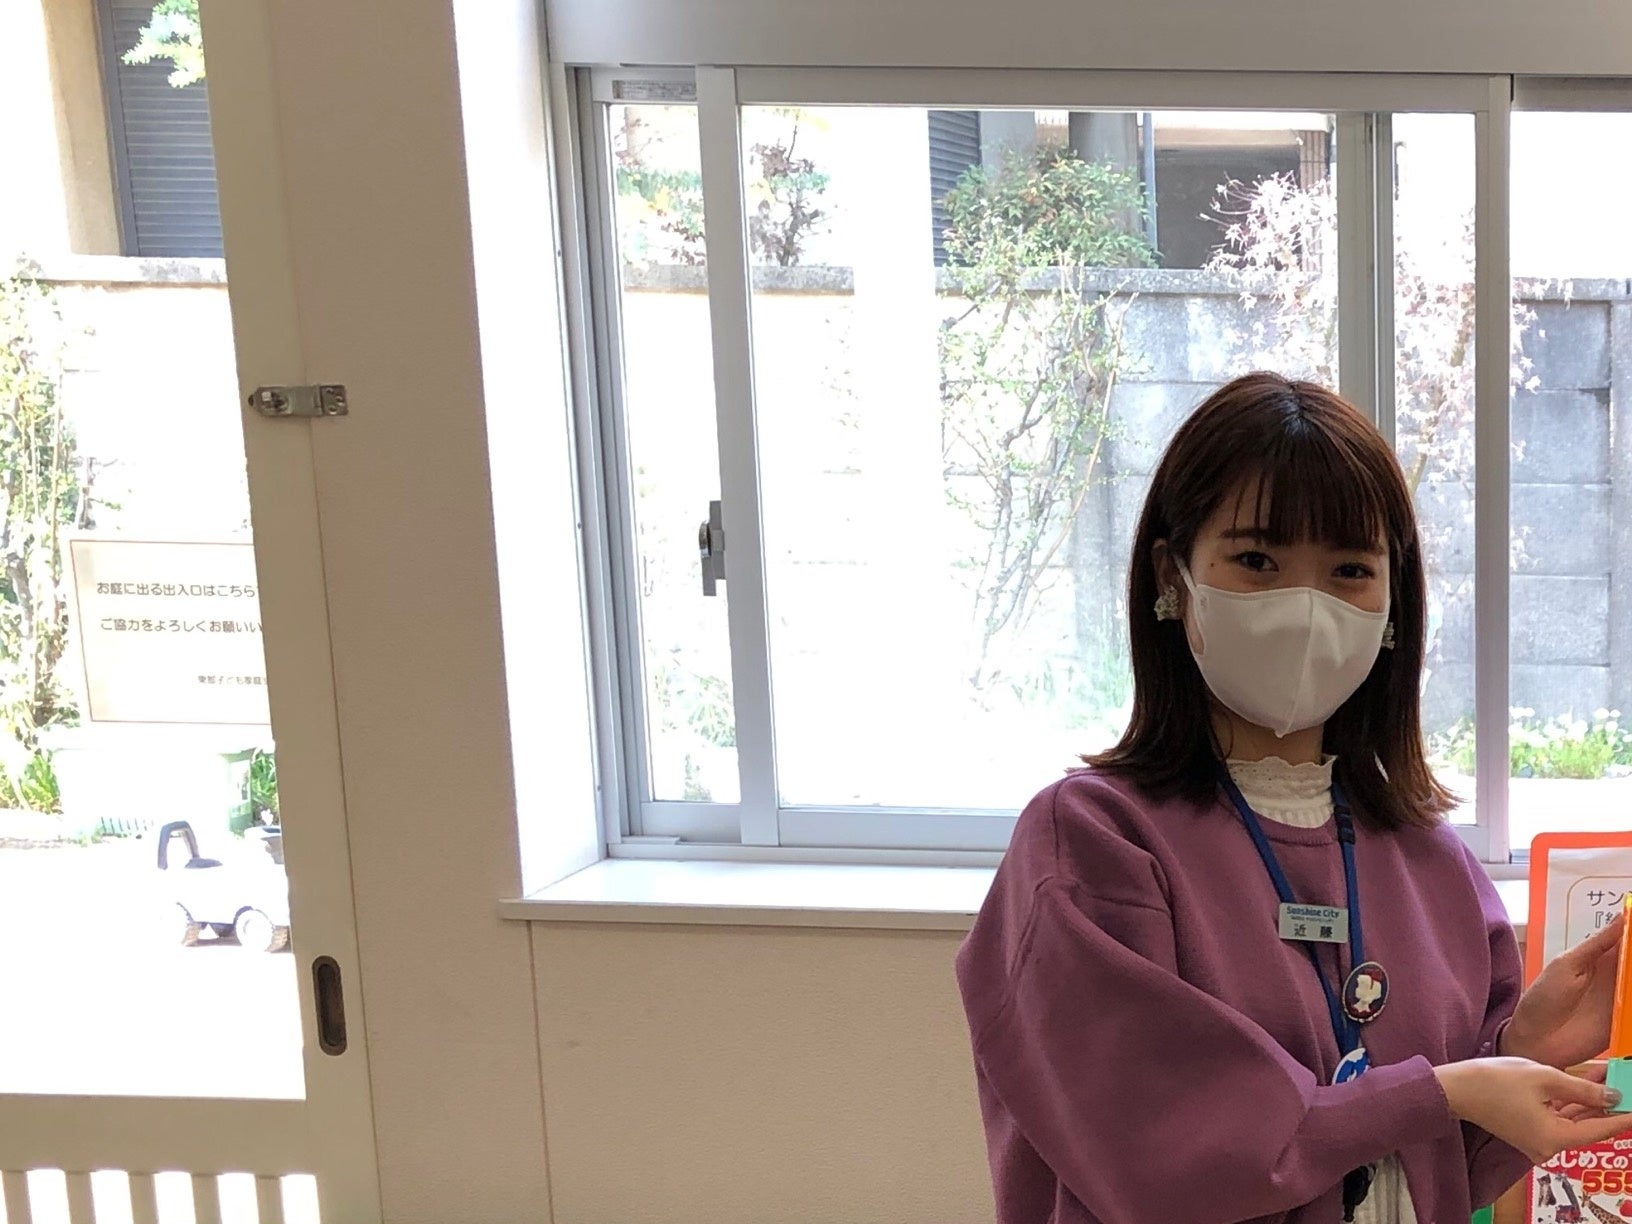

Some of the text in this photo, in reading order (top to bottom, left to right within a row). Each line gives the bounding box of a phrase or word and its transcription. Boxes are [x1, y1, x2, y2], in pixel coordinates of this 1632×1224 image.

[97, 582, 259, 598] お庭に出る出入口はこちら
[197, 674, 267, 686] 東部子ども家庭
[1286, 905, 1322, 917] Sunshine
[1322, 909, 1340, 919] City
